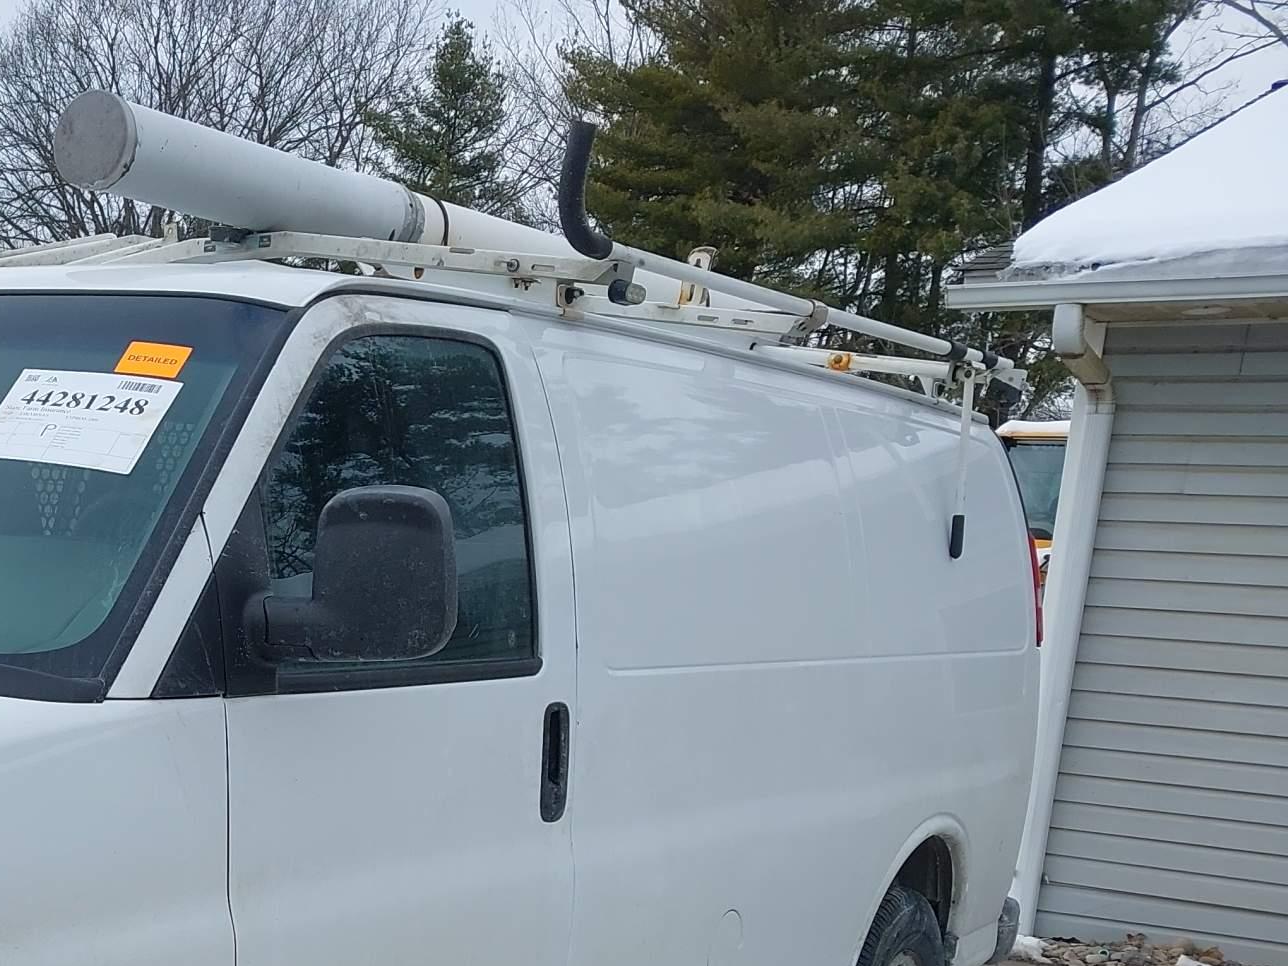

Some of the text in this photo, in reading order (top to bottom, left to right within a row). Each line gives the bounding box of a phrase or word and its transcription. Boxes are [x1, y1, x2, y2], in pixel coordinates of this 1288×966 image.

[127, 354, 178, 366] DETAILED
[21, 389, 150, 415] 44281248
[40, 424, 57, 437] P
